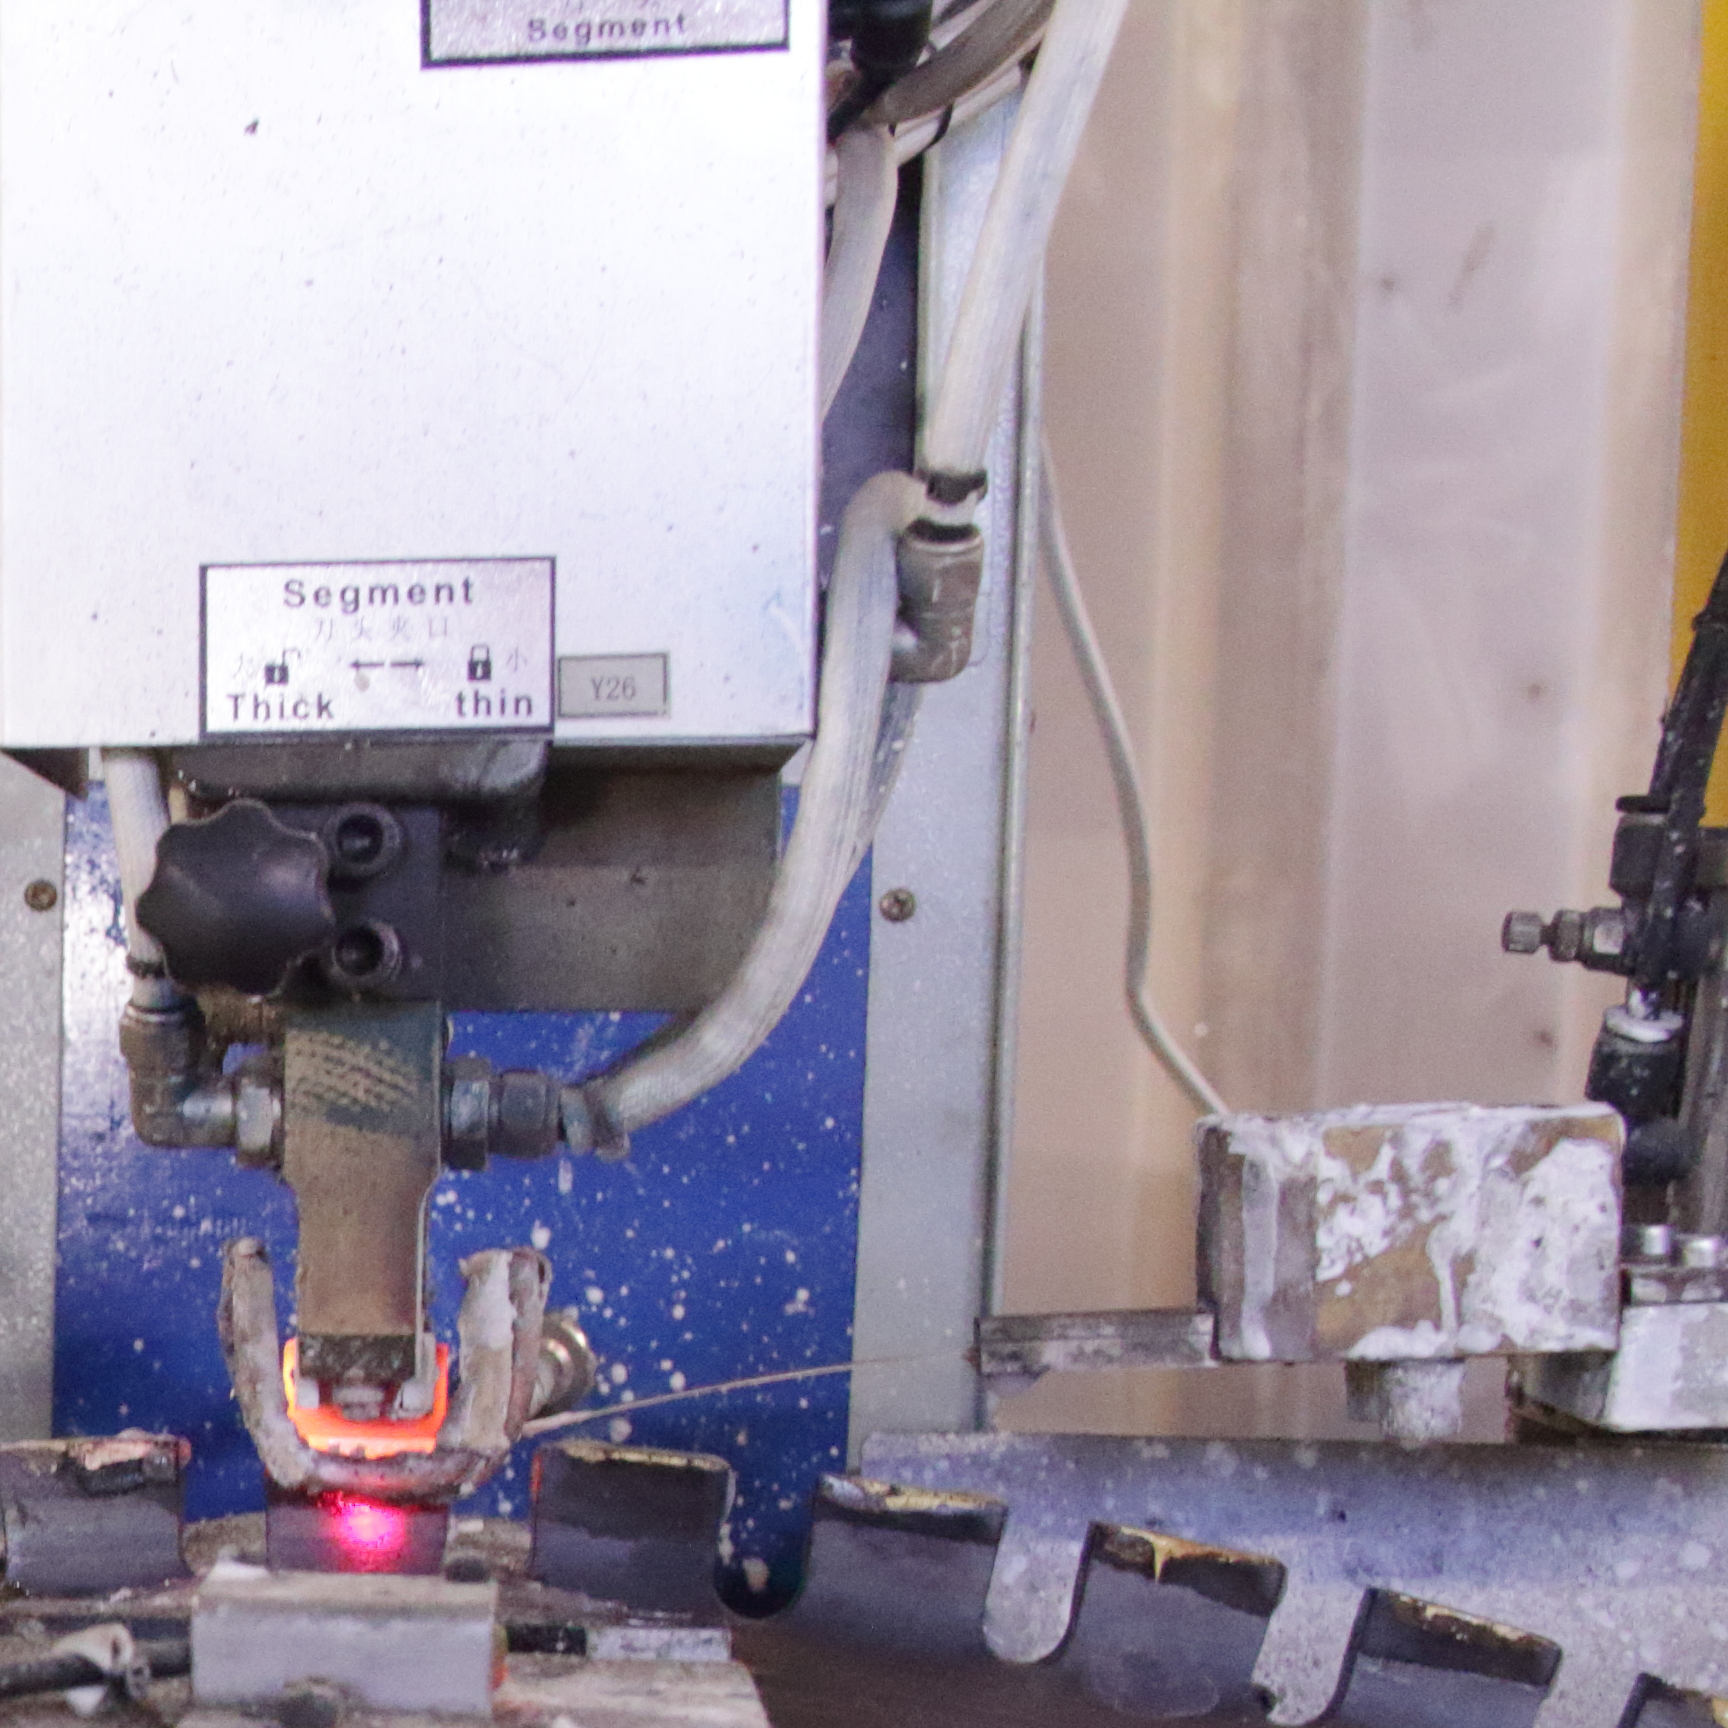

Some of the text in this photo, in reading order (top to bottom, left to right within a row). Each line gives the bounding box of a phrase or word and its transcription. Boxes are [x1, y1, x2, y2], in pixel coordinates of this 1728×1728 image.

[527, 12, 686, 46] Segment
[283, 577, 475, 614] Segment
[226, 692, 335, 723] Thick
[455, 689, 533, 719] thin
